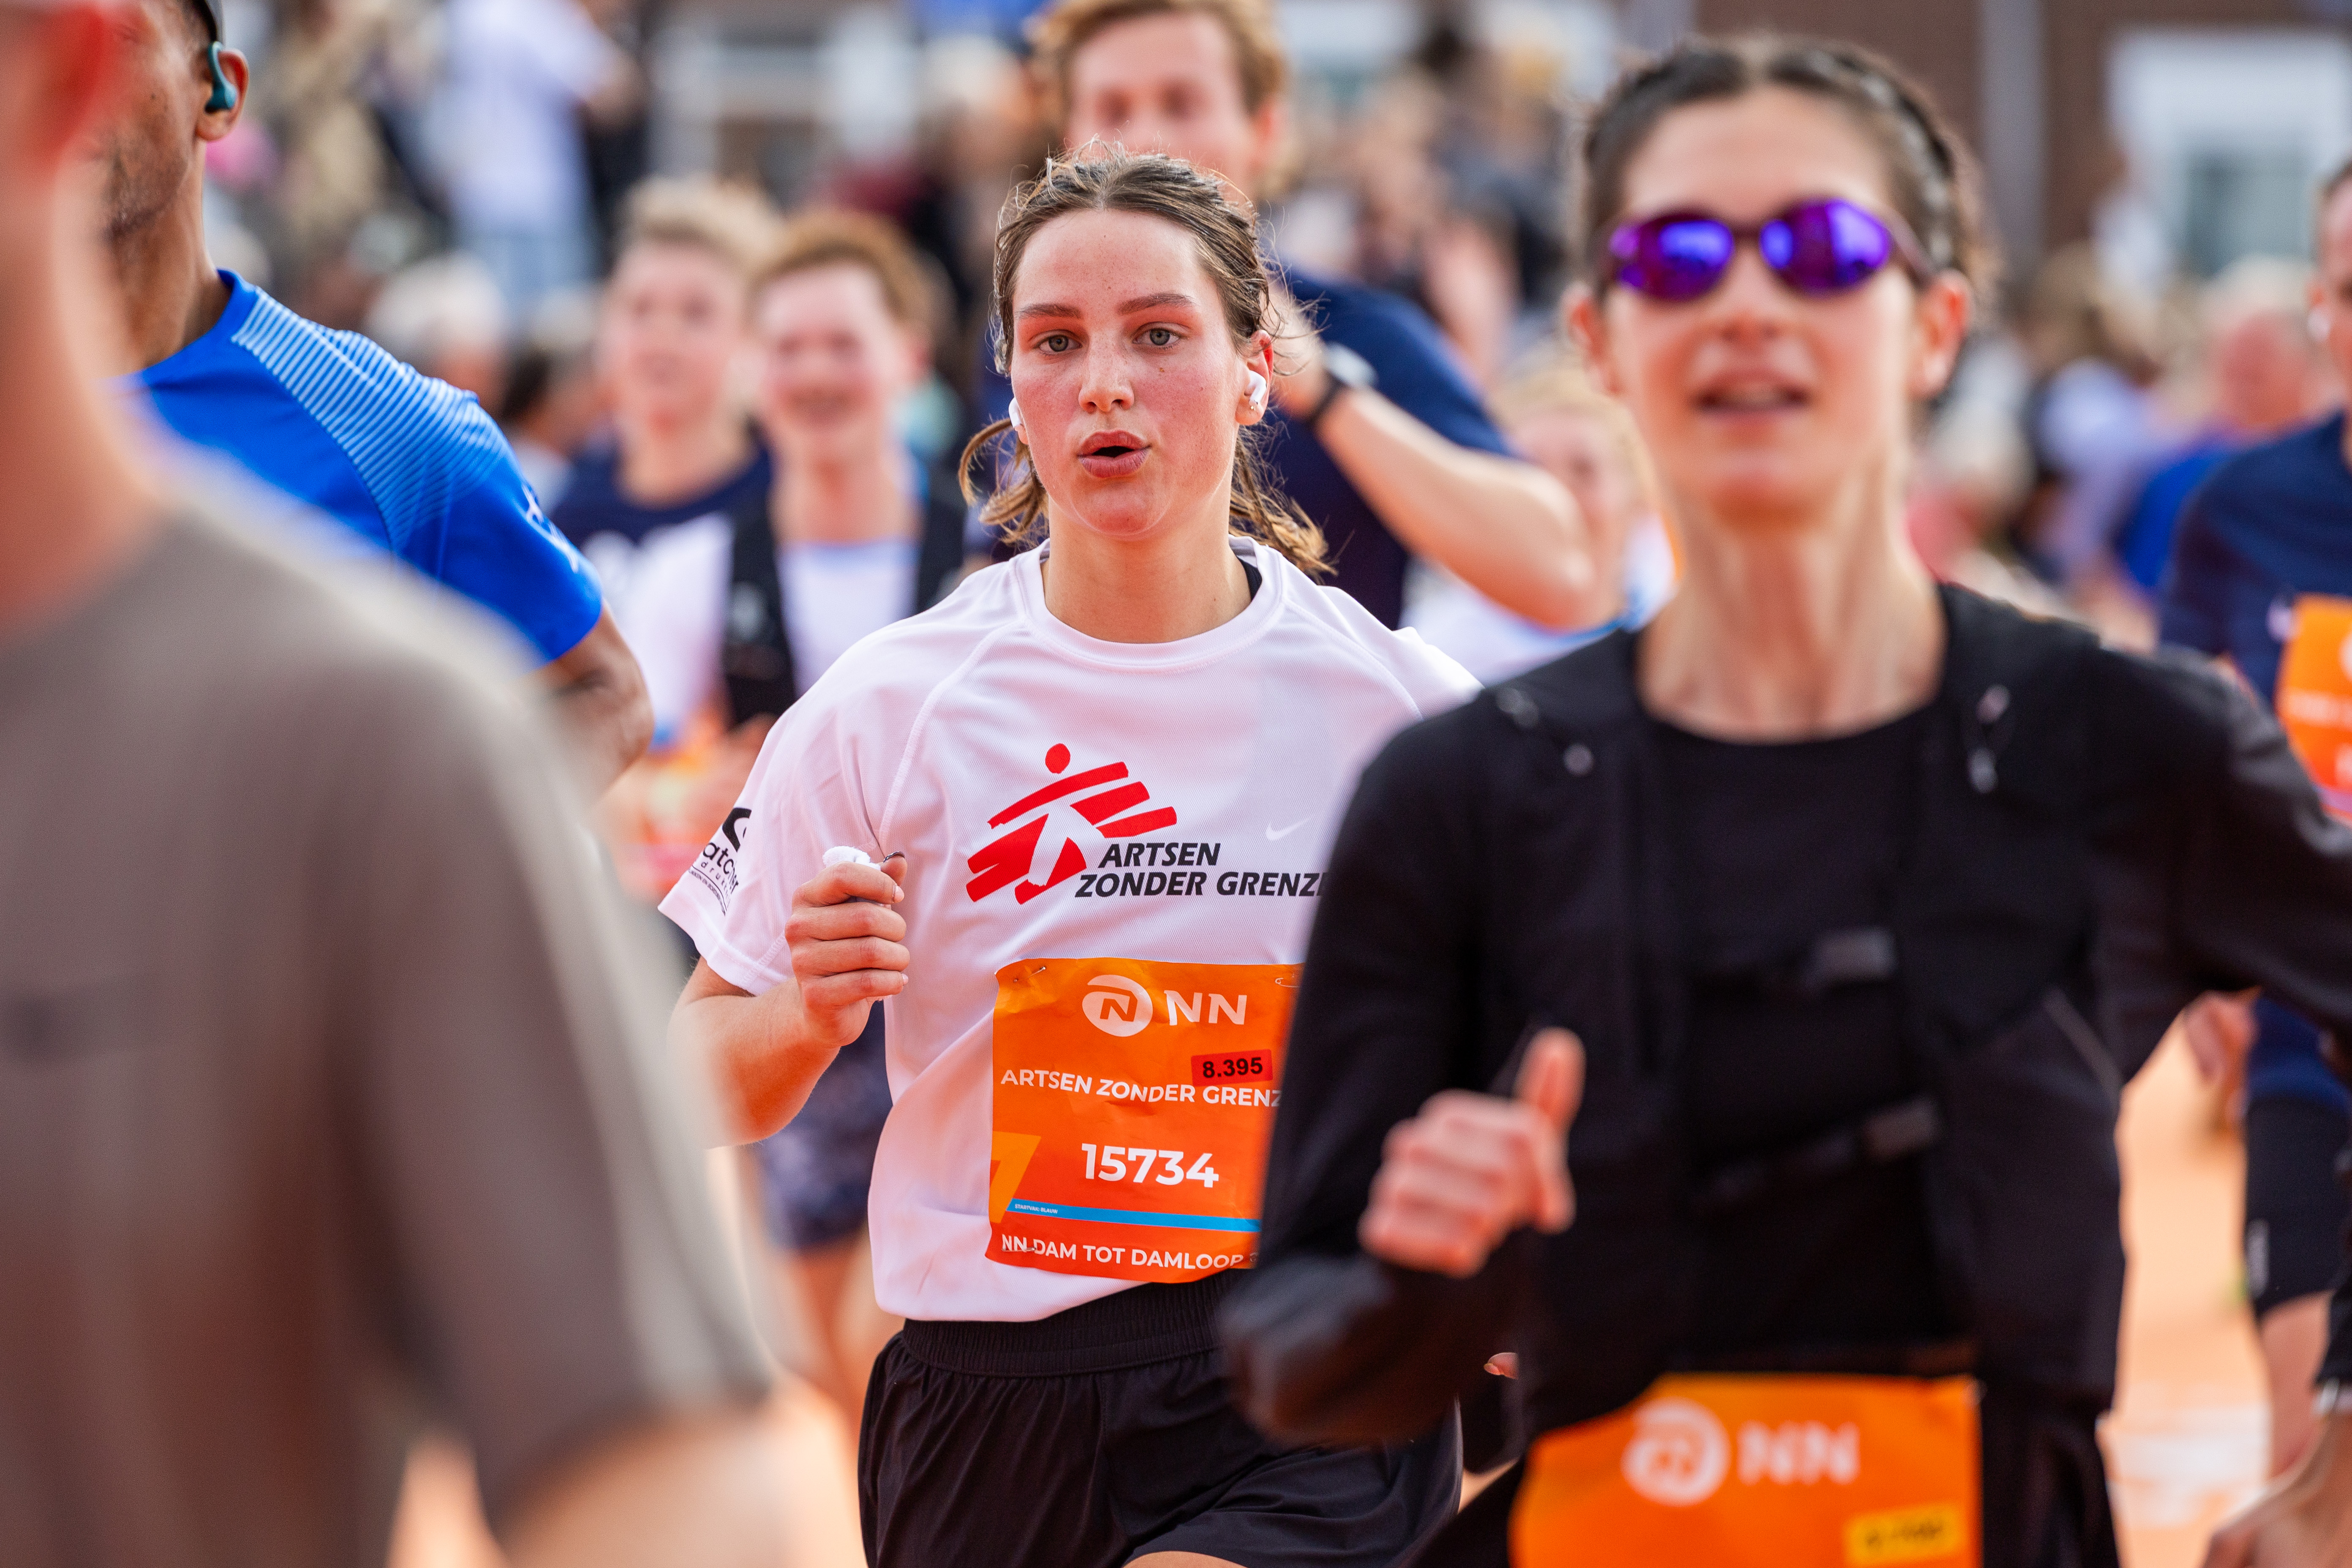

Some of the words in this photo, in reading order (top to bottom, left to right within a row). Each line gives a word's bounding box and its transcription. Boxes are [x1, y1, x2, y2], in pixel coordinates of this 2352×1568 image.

[1097, 843, 1221, 868] ARTSEN
[1075, 871, 1207, 898] ZONDER
[1164, 990, 1247, 1026] NN
[1203, 1057, 1263, 1078] 8.395
[1001, 1069, 1092, 1094] ARTSEN
[1096, 1078, 1196, 1103] ZONDER
[1081, 1143, 1220, 1189] 15734
[1014, 1203, 1040, 1211] STARTVAK:
[1002, 1234, 1027, 1253] NN
[1033, 1239, 1077, 1260] DAM
[1083, 1245, 1126, 1264] TOT
[1131, 1249, 1244, 1270] DAMLOOP
